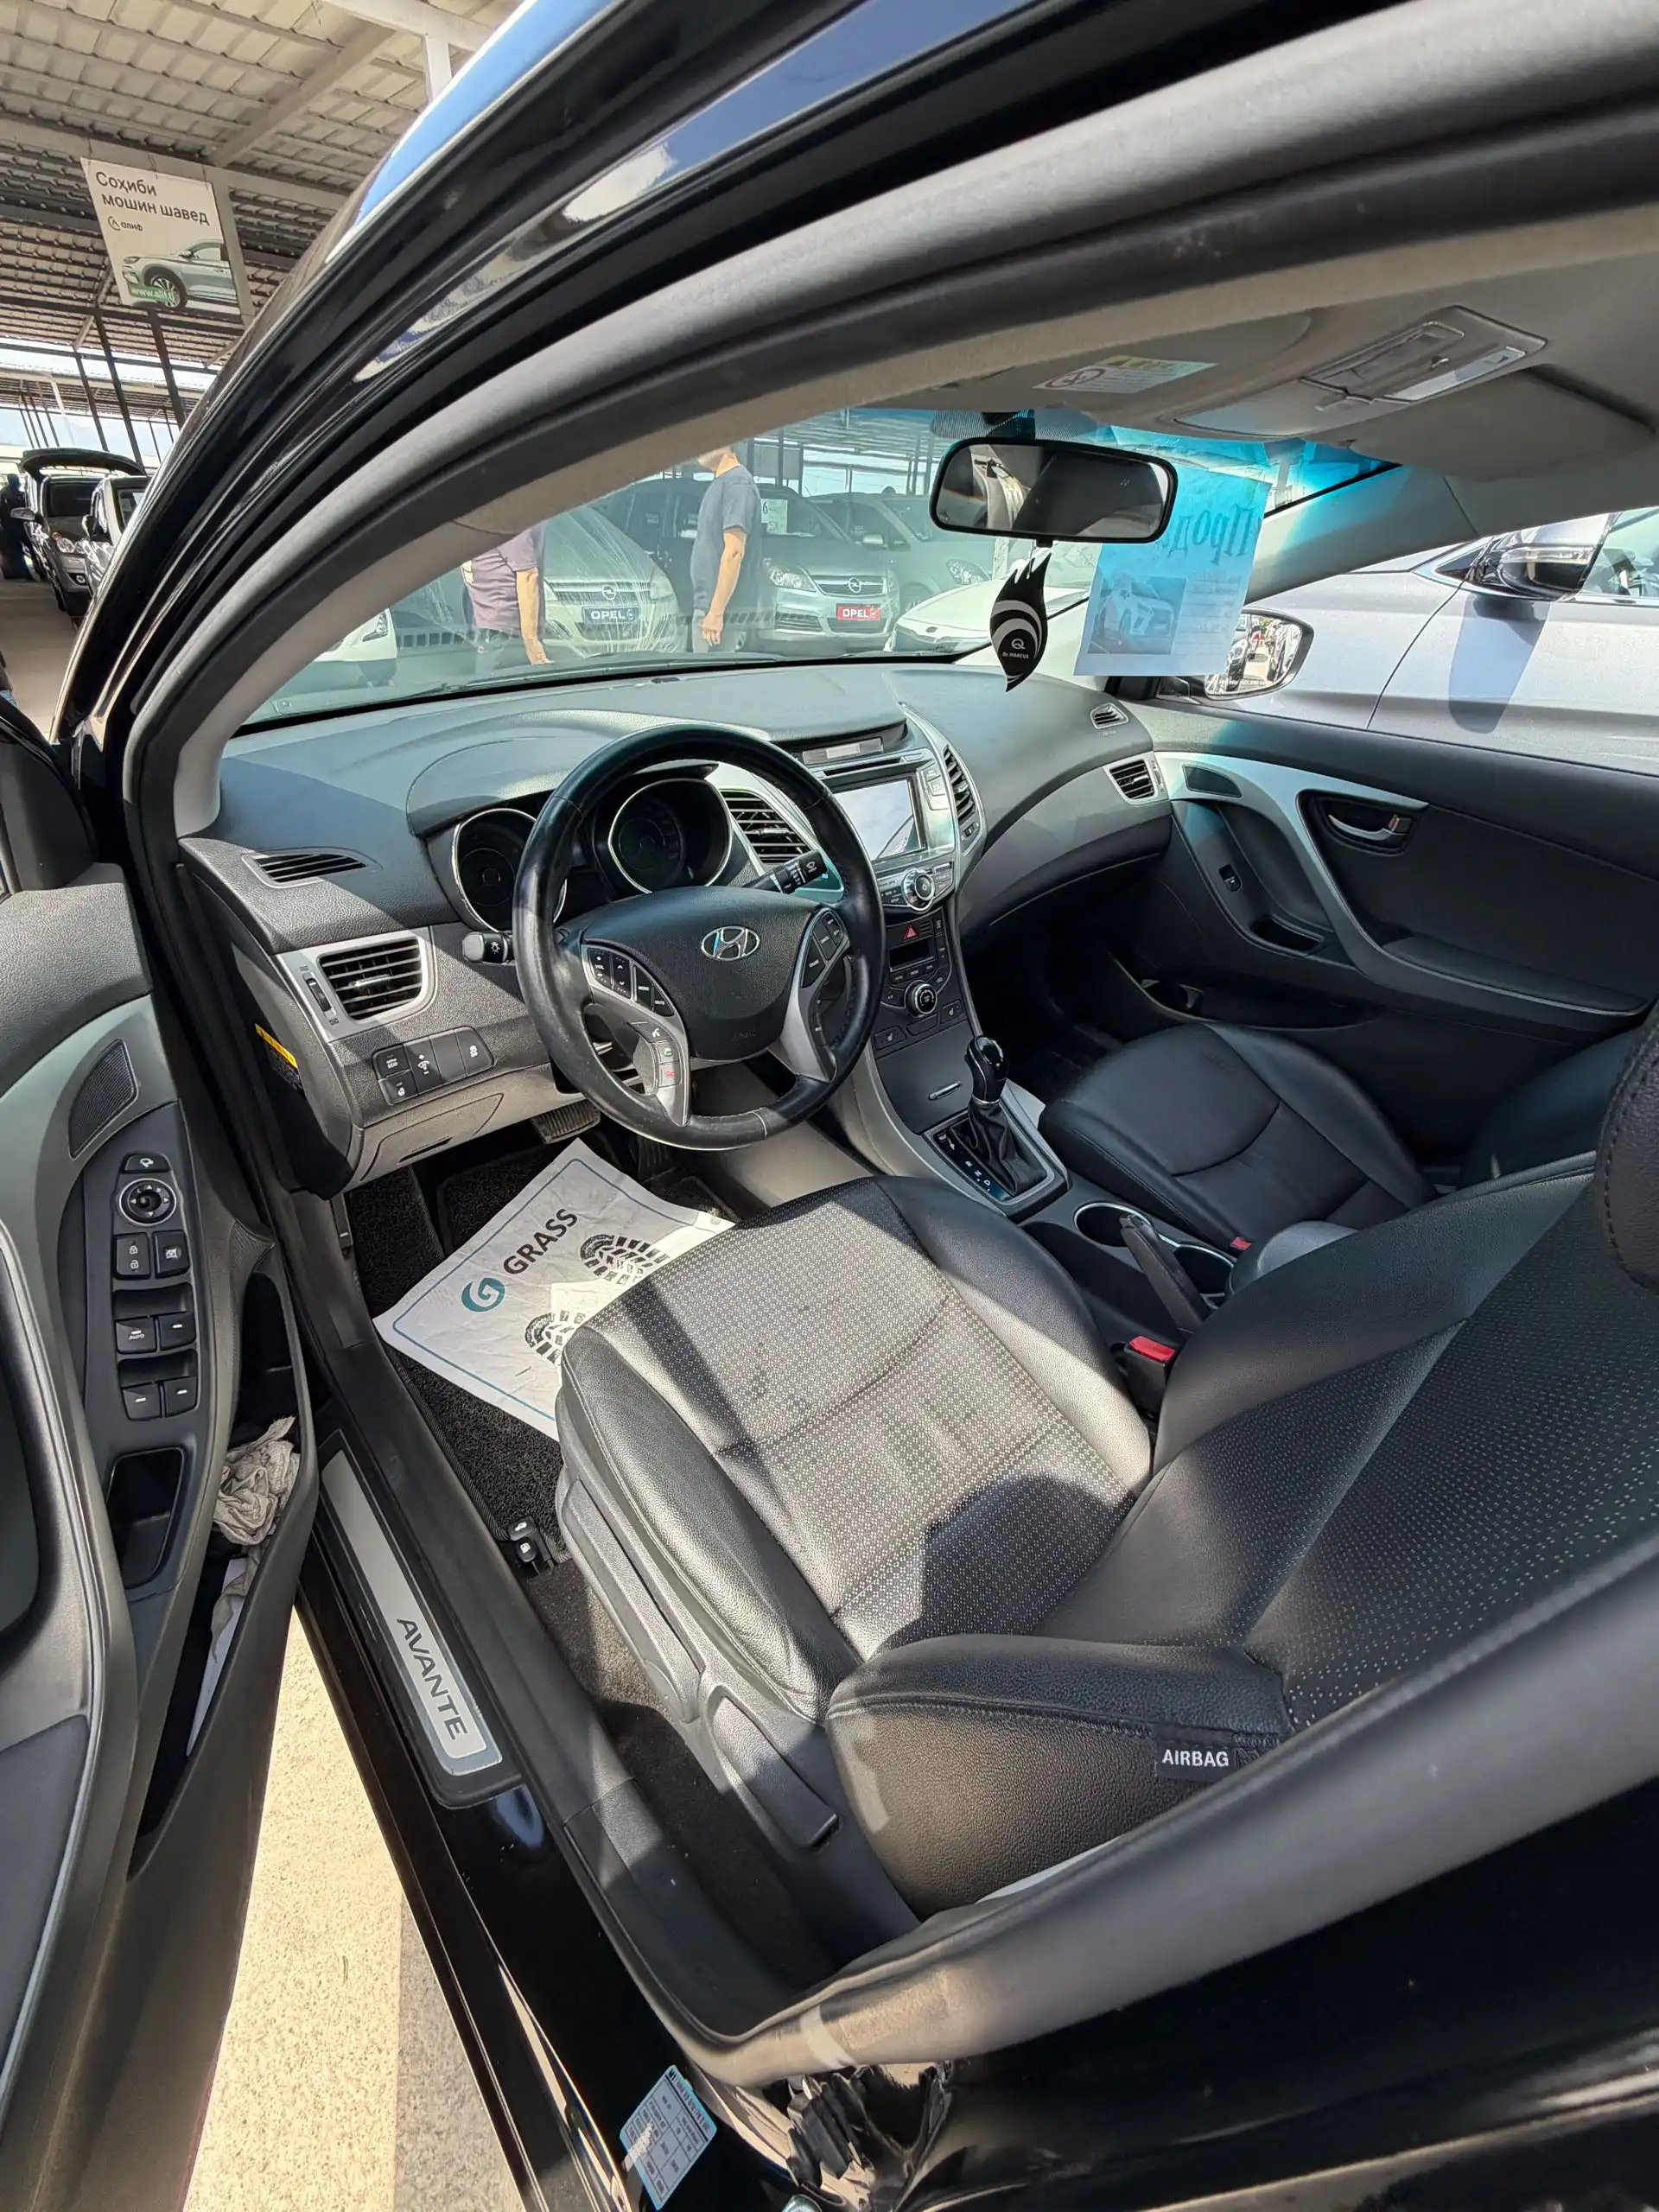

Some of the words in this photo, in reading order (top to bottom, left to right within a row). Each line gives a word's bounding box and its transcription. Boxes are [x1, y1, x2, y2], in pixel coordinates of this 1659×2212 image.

[101, 194, 157, 214] мошин
[160, 204, 210, 226] шавед
[590, 610, 626, 620] OPEL
[842, 607, 869, 619] OPEL
[503, 1208, 578, 1274] GRASS
[396, 1618, 468, 1741] AVANTE
[1161, 1749, 1229, 1768] AIRBAG
